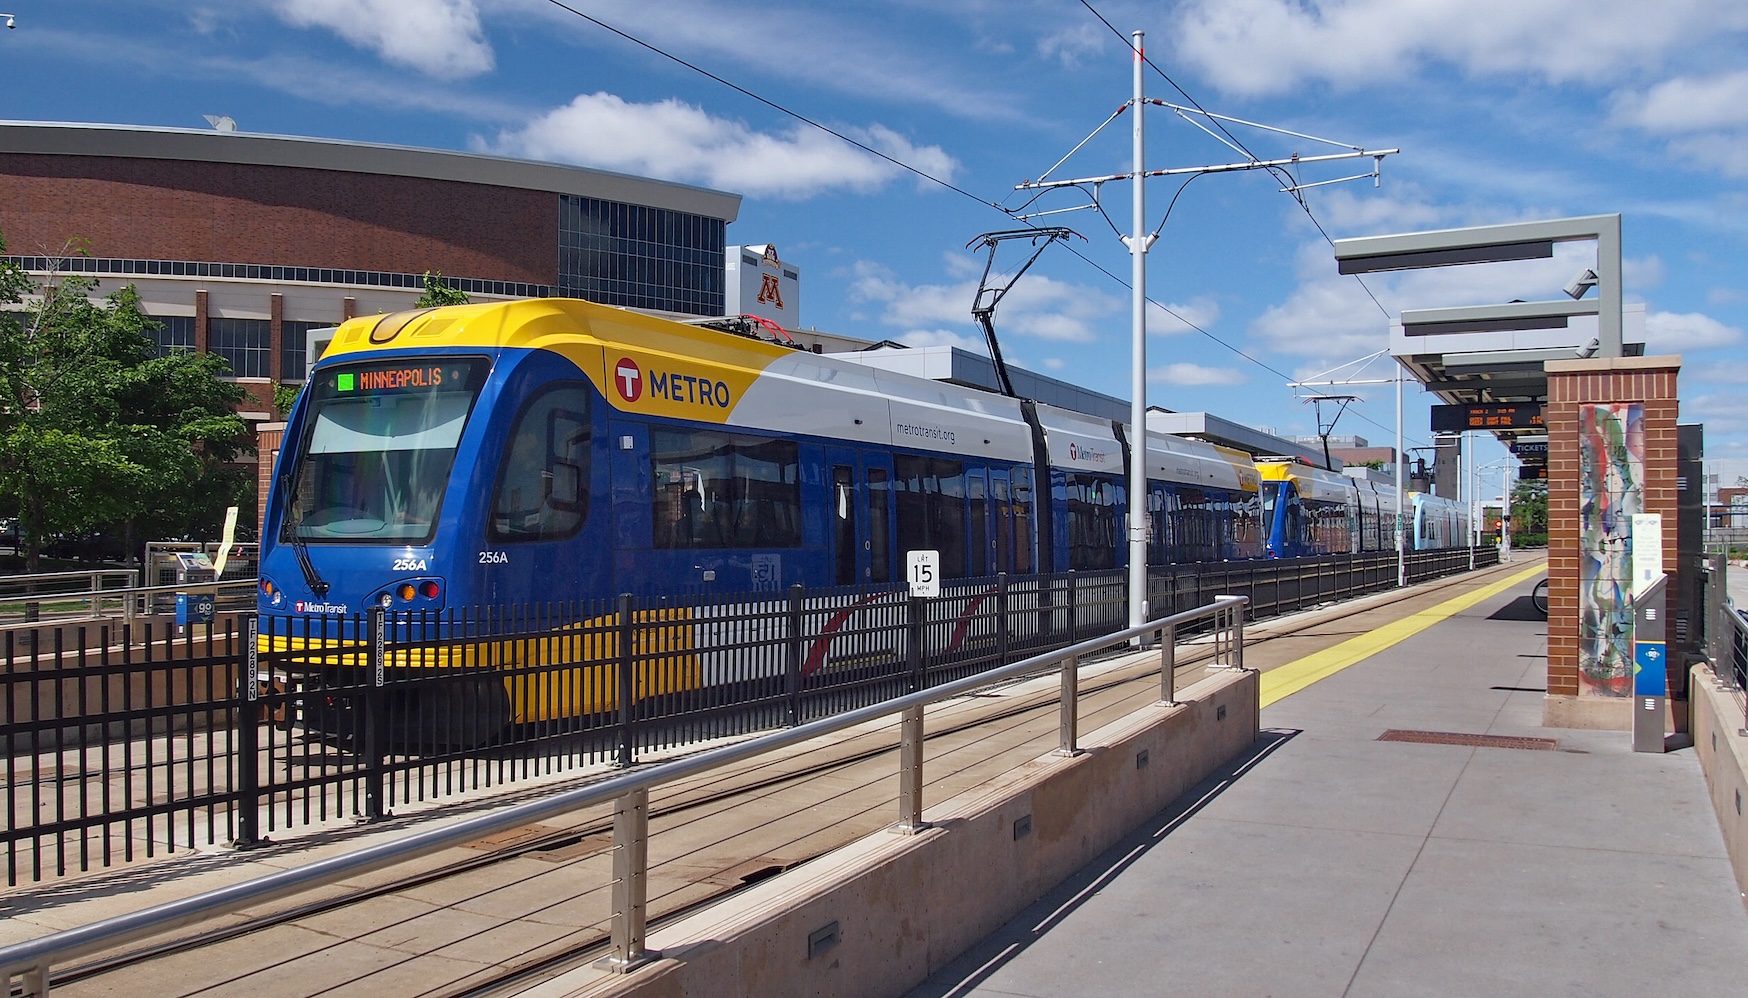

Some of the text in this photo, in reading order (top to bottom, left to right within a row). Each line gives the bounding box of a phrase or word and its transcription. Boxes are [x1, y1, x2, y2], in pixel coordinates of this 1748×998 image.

[757, 272, 784, 310] M
[360, 367, 442, 390] MINNEAPOLIS
[617, 366, 730, 408] T METRO
[896, 423, 955, 445] metrotransit.org
[1516, 444, 1548, 452] TICKETS
[392, 559, 427, 571] 256A
[479, 551, 508, 564] 256A
[914, 564, 933, 583] 15
[198, 602, 212, 614] go
